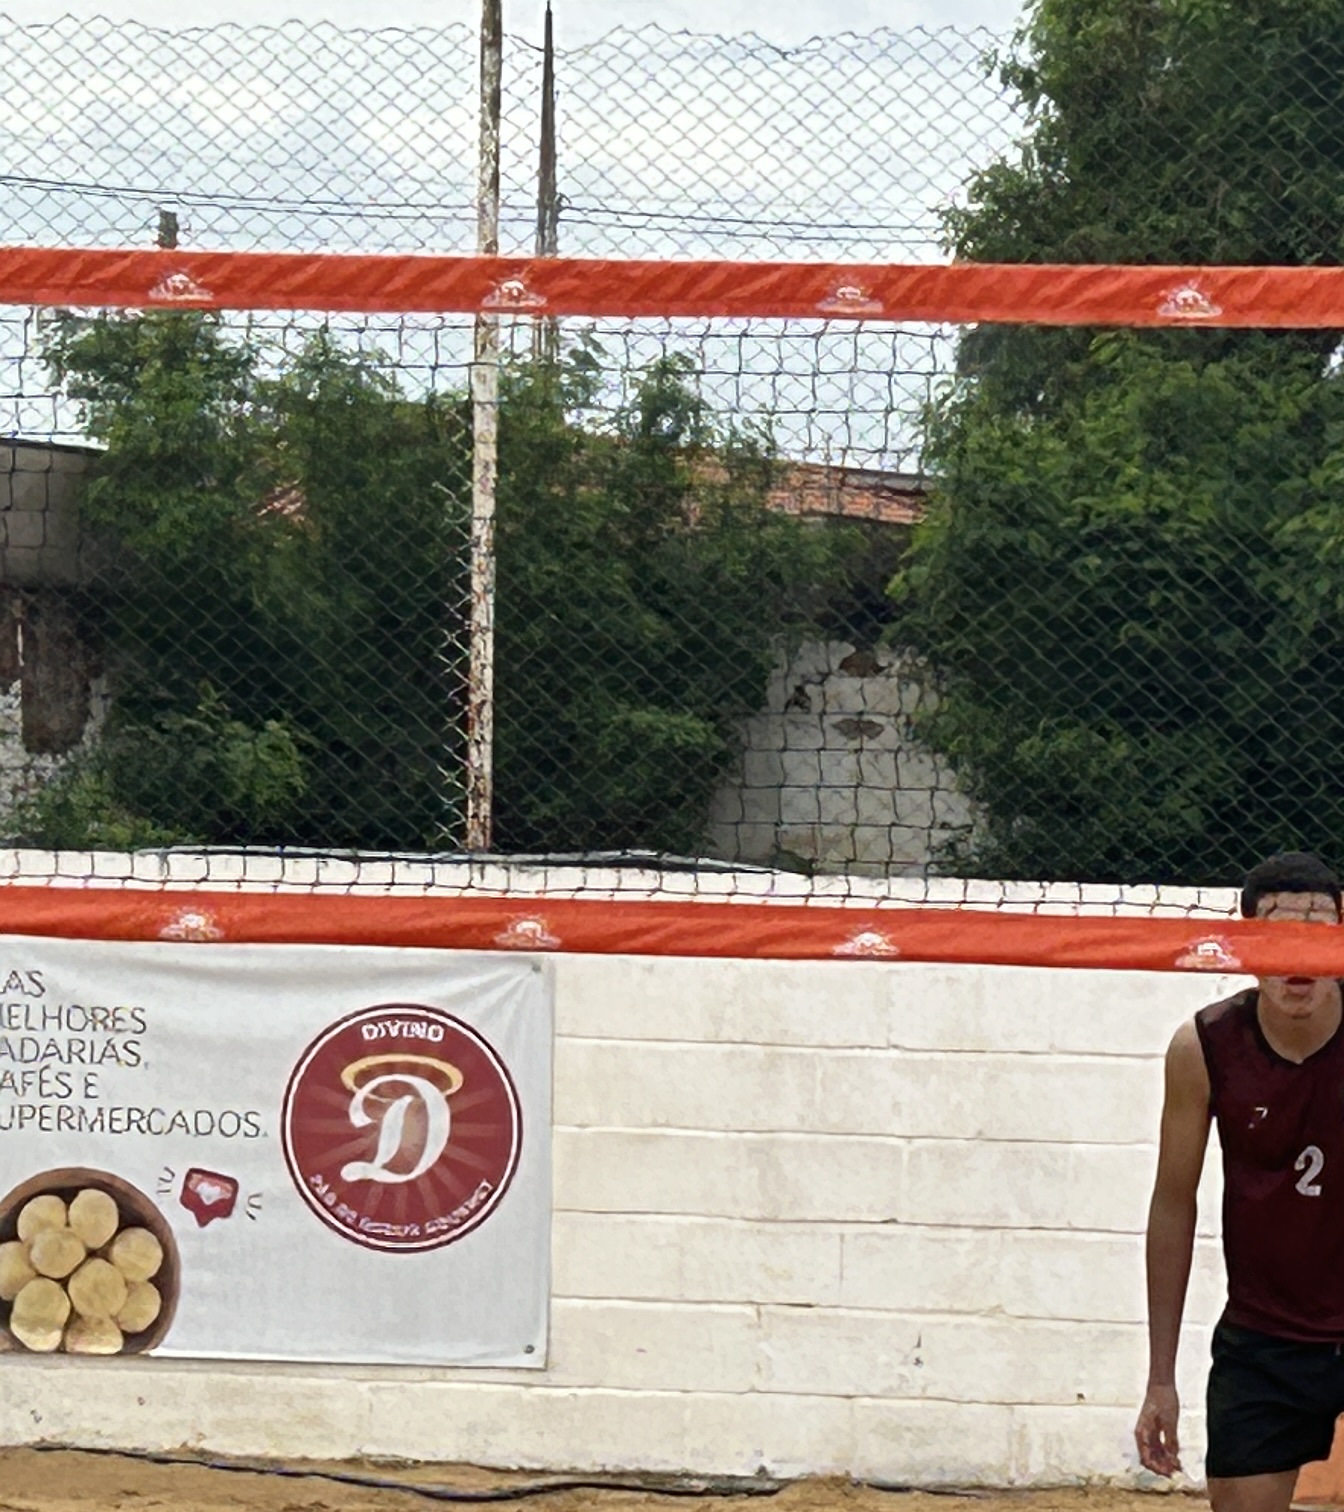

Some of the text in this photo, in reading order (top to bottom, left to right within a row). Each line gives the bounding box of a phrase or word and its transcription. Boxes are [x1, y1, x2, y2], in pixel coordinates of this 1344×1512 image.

[0, 970, 46, 998] AS
[361, 1019, 446, 1043] DIVINO
[84, 1072, 100, 1099] E
[1293, 1144, 1326, 1197] 2
